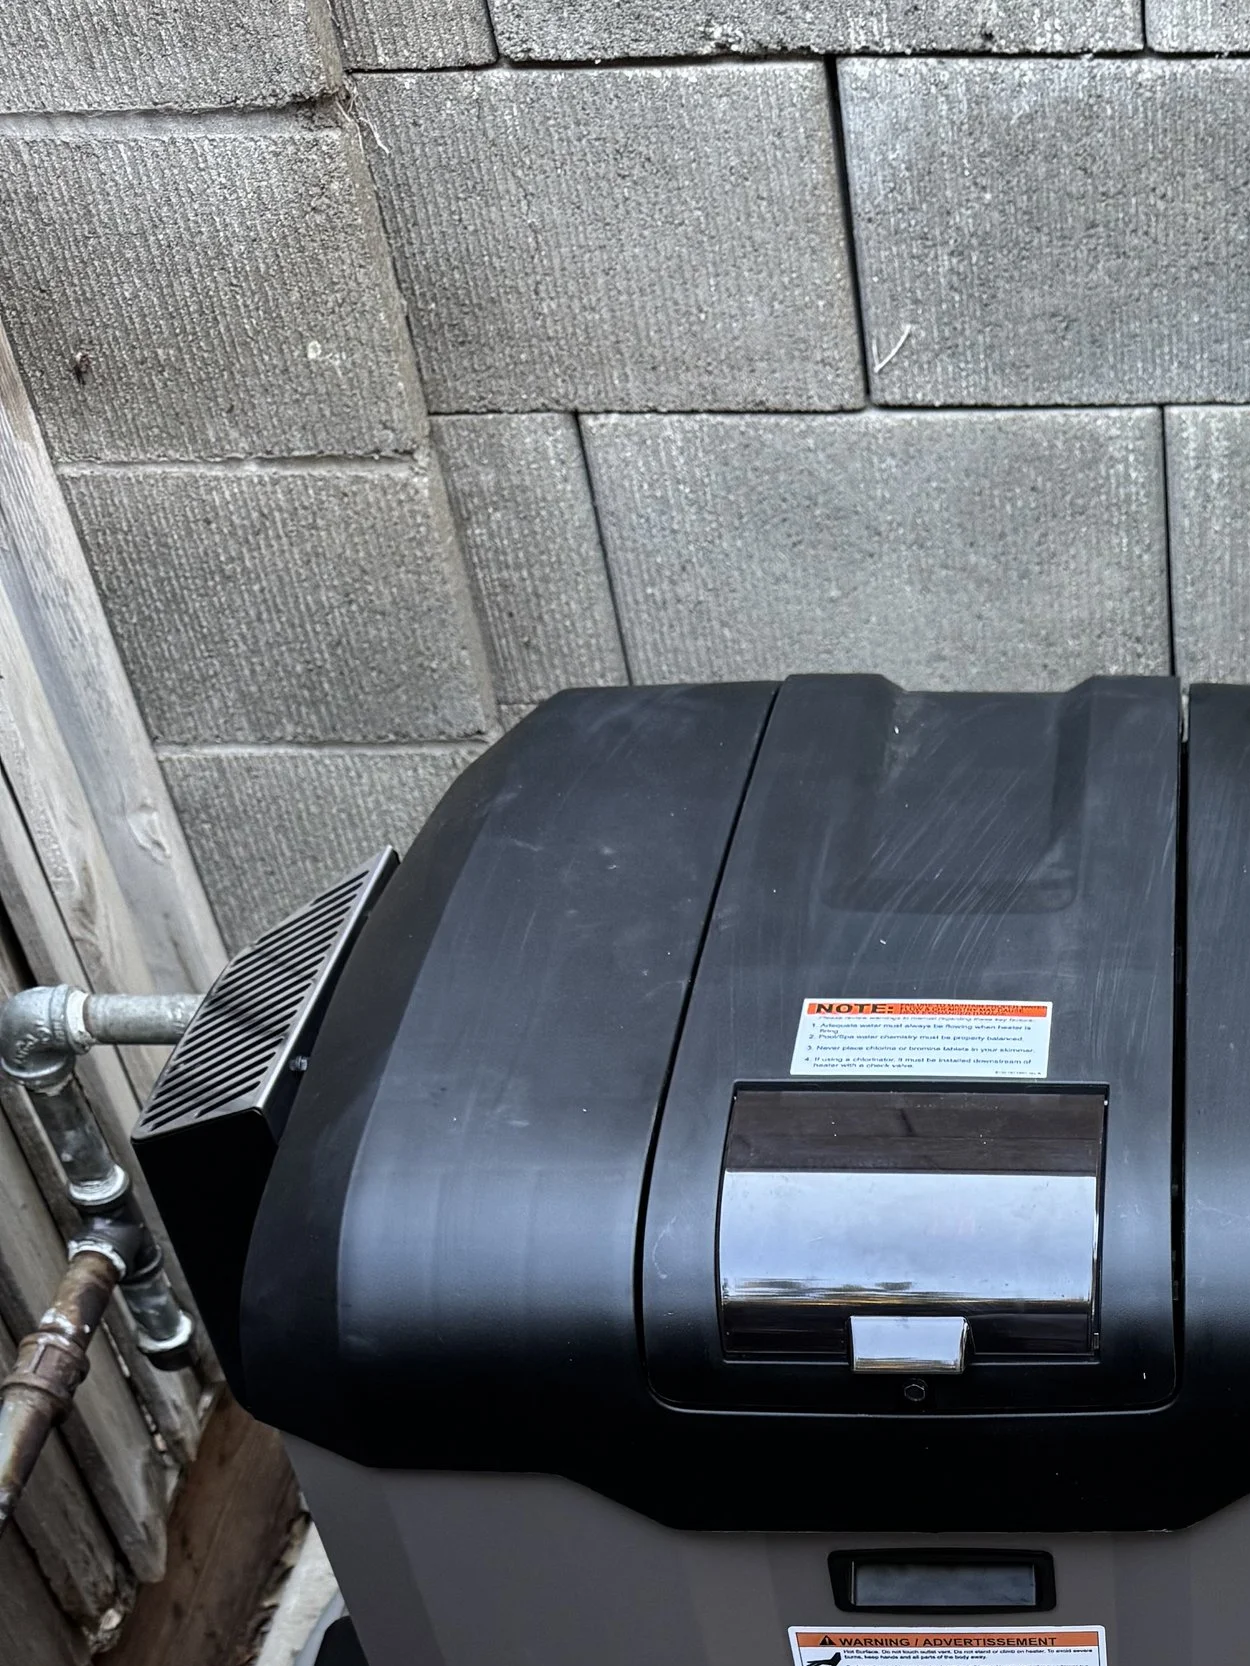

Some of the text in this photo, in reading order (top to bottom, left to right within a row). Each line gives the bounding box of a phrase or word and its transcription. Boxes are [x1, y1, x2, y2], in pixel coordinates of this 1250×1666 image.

[816, 1003, 894, 1014] NOTE:
[839, 1638, 910, 1647] WARNING
[923, 1637, 1057, 1647] ADVERTISSEMENT
